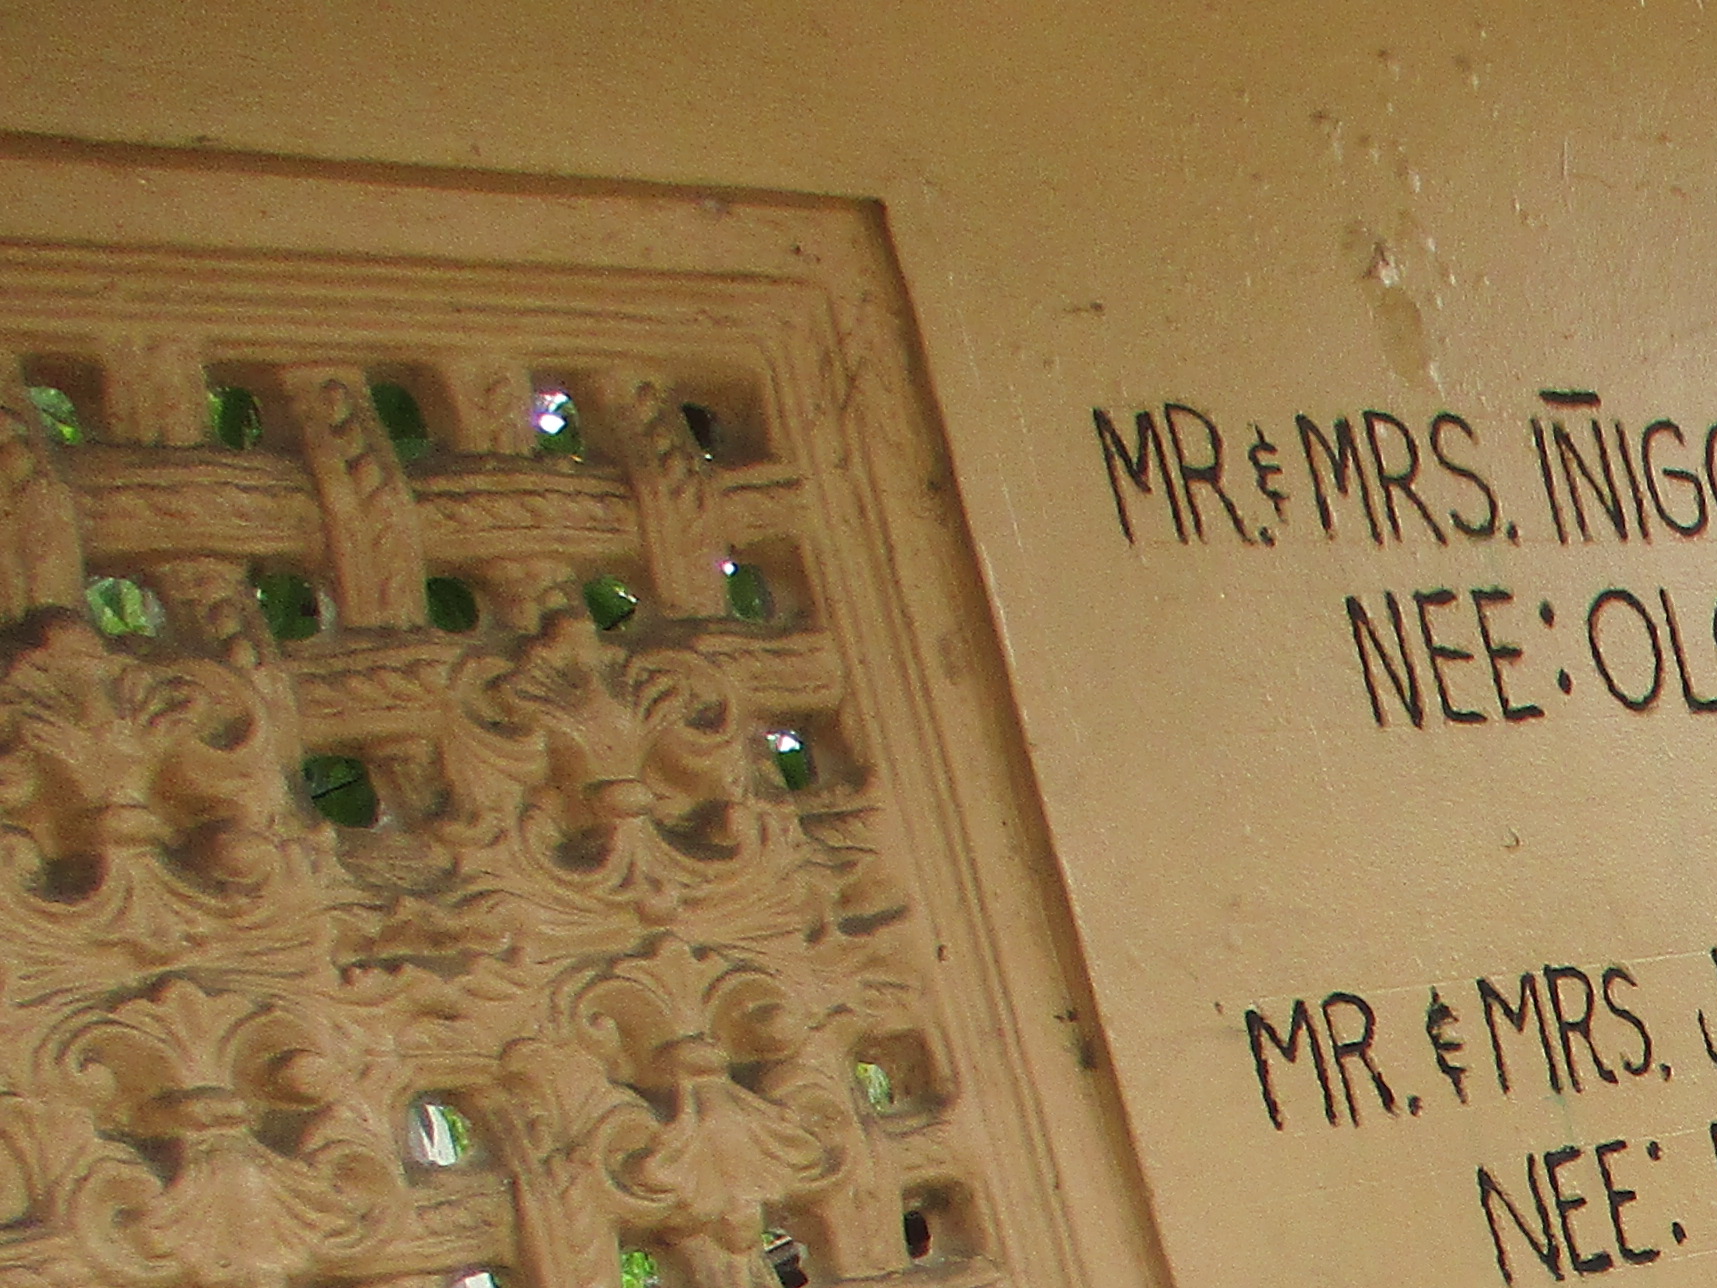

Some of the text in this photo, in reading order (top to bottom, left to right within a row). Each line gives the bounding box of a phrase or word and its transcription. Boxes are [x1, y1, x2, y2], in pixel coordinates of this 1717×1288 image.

[1294, 408, 1520, 548] MRS.
[1245, 991, 1423, 1131] MR.
[1477, 963, 1673, 1095] MRS.
[1477, 1139, 1690, 1287] NEE:
